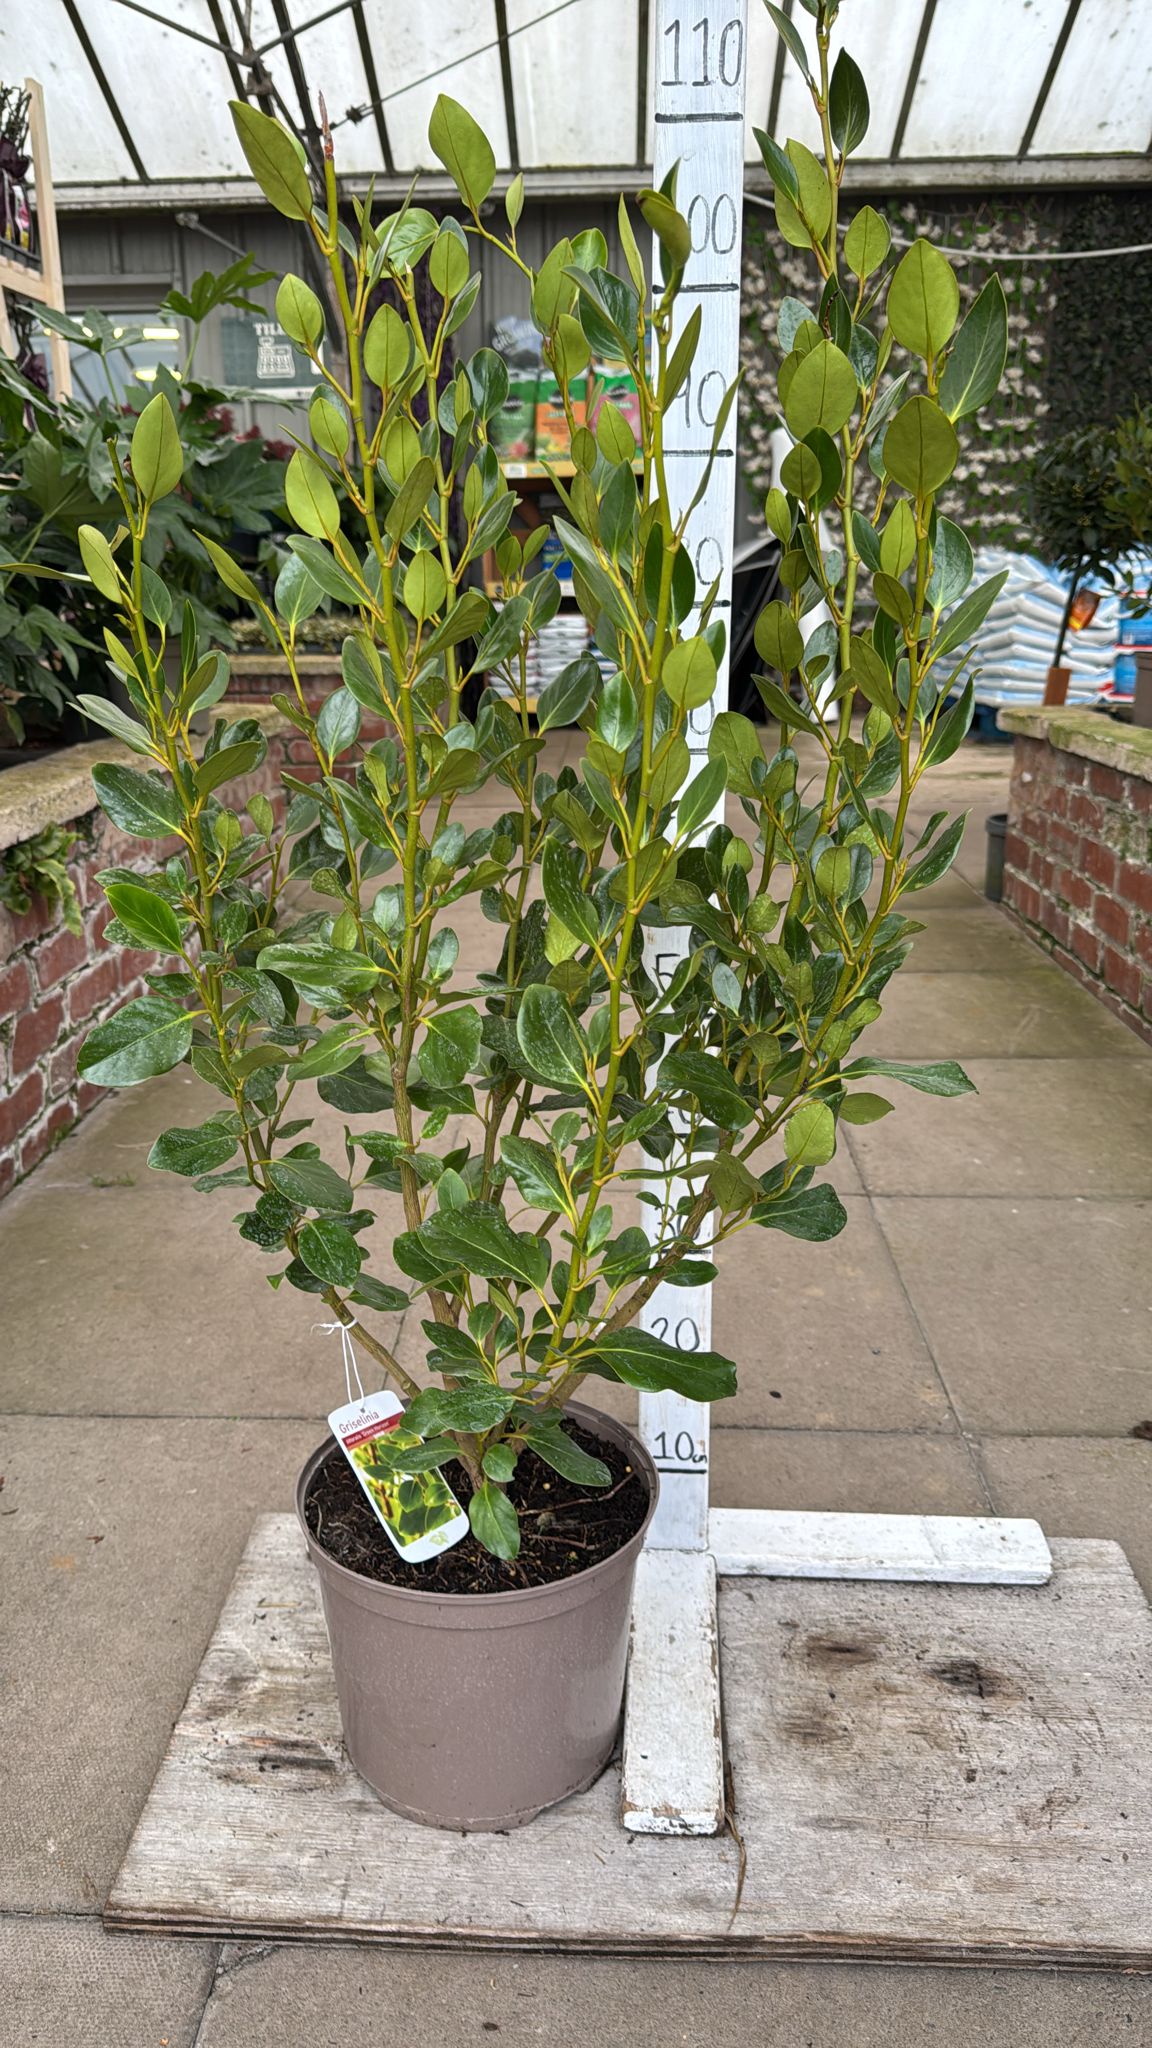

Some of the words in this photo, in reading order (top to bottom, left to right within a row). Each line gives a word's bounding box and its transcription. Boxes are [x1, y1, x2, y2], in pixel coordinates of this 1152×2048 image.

[661, 18, 743, 86] 110
[688, 193, 736, 254] 00
[338, 1411, 380, 1434] Griselinia
